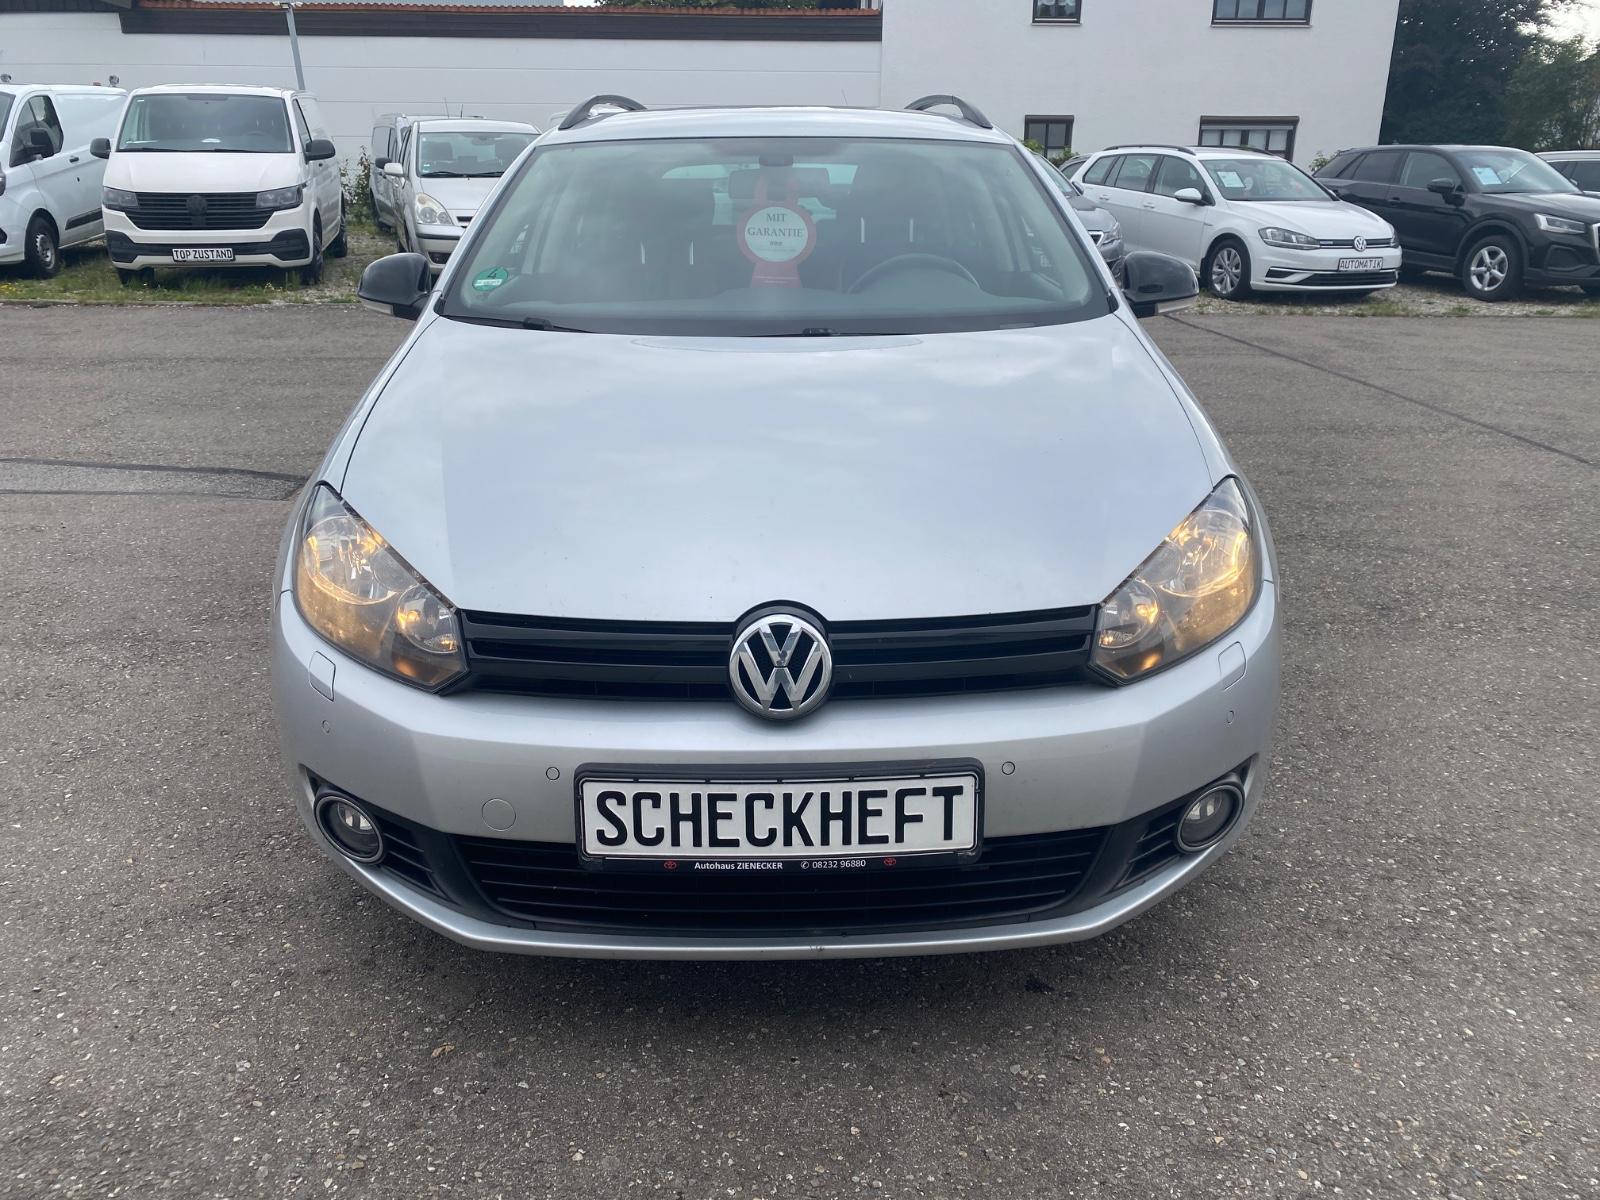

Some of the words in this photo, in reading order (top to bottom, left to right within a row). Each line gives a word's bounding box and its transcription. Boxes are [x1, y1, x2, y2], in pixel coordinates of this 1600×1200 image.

[766, 213, 786, 222] MIT
[747, 226, 804, 238] GARANTIE
[1354, 236, 1367, 251] VW
[174, 249, 191, 259] TOP
[193, 248, 233, 259] ZUSTAND
[1340, 259, 1381, 269] AUTOMATIK
[488, 268, 497, 279] 4
[729, 614, 832, 719] VW
[595, 785, 964, 848] SCHECKHEFT
[694, 862, 735, 870] Autohaus
[736, 862, 783, 870] ZIENECKER
[812, 860, 838, 869] 08232
[840, 859, 867, 868] 96880
